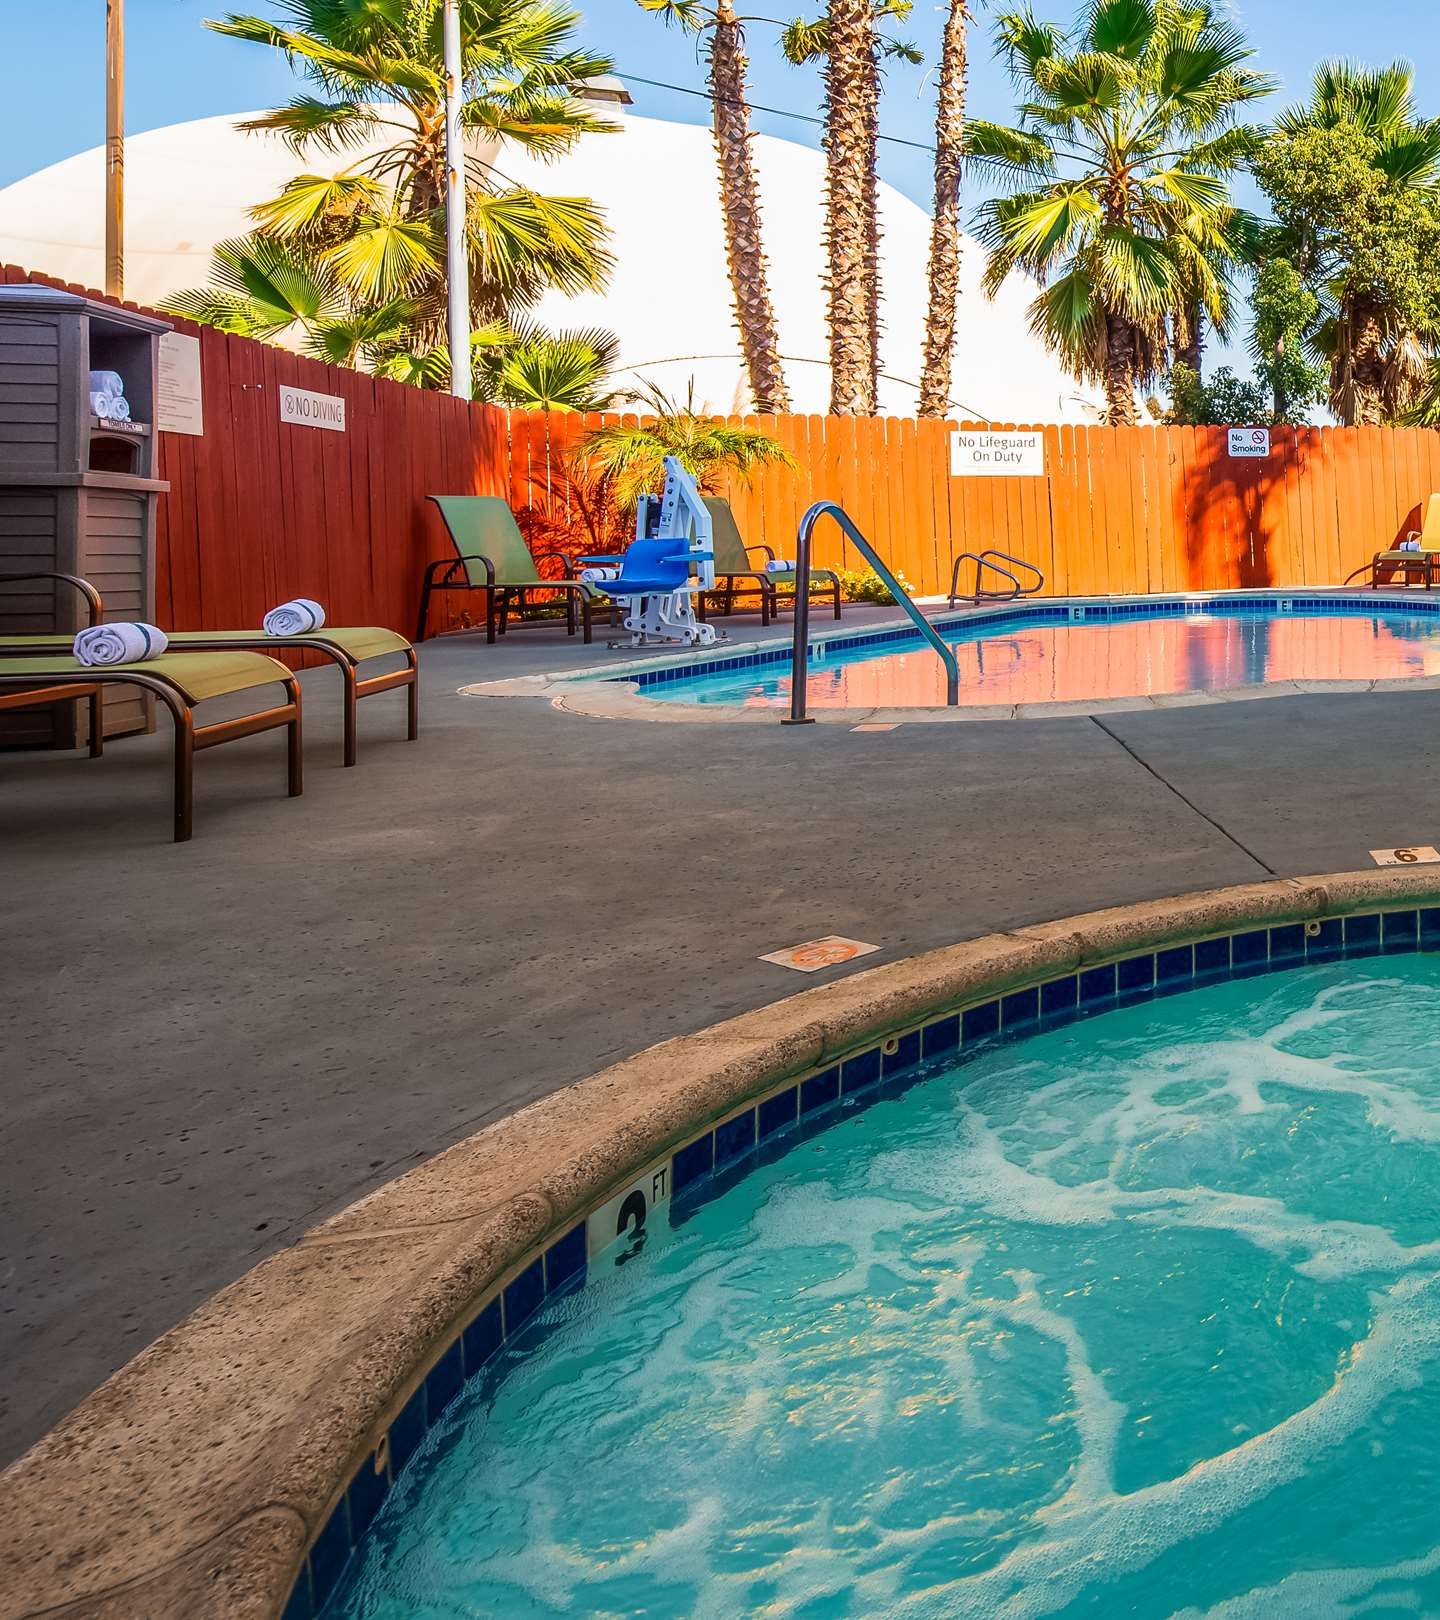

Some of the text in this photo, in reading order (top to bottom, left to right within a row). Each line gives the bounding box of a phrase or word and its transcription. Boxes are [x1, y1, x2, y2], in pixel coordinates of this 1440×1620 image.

[296, 396, 342, 423] NO DIVING
[958, 436, 1035, 450] No Lifeguard
[1231, 434, 1266, 454] No Smoking
[973, 450, 1022, 464] On Duty
[652, 1168, 667, 1203] FT
